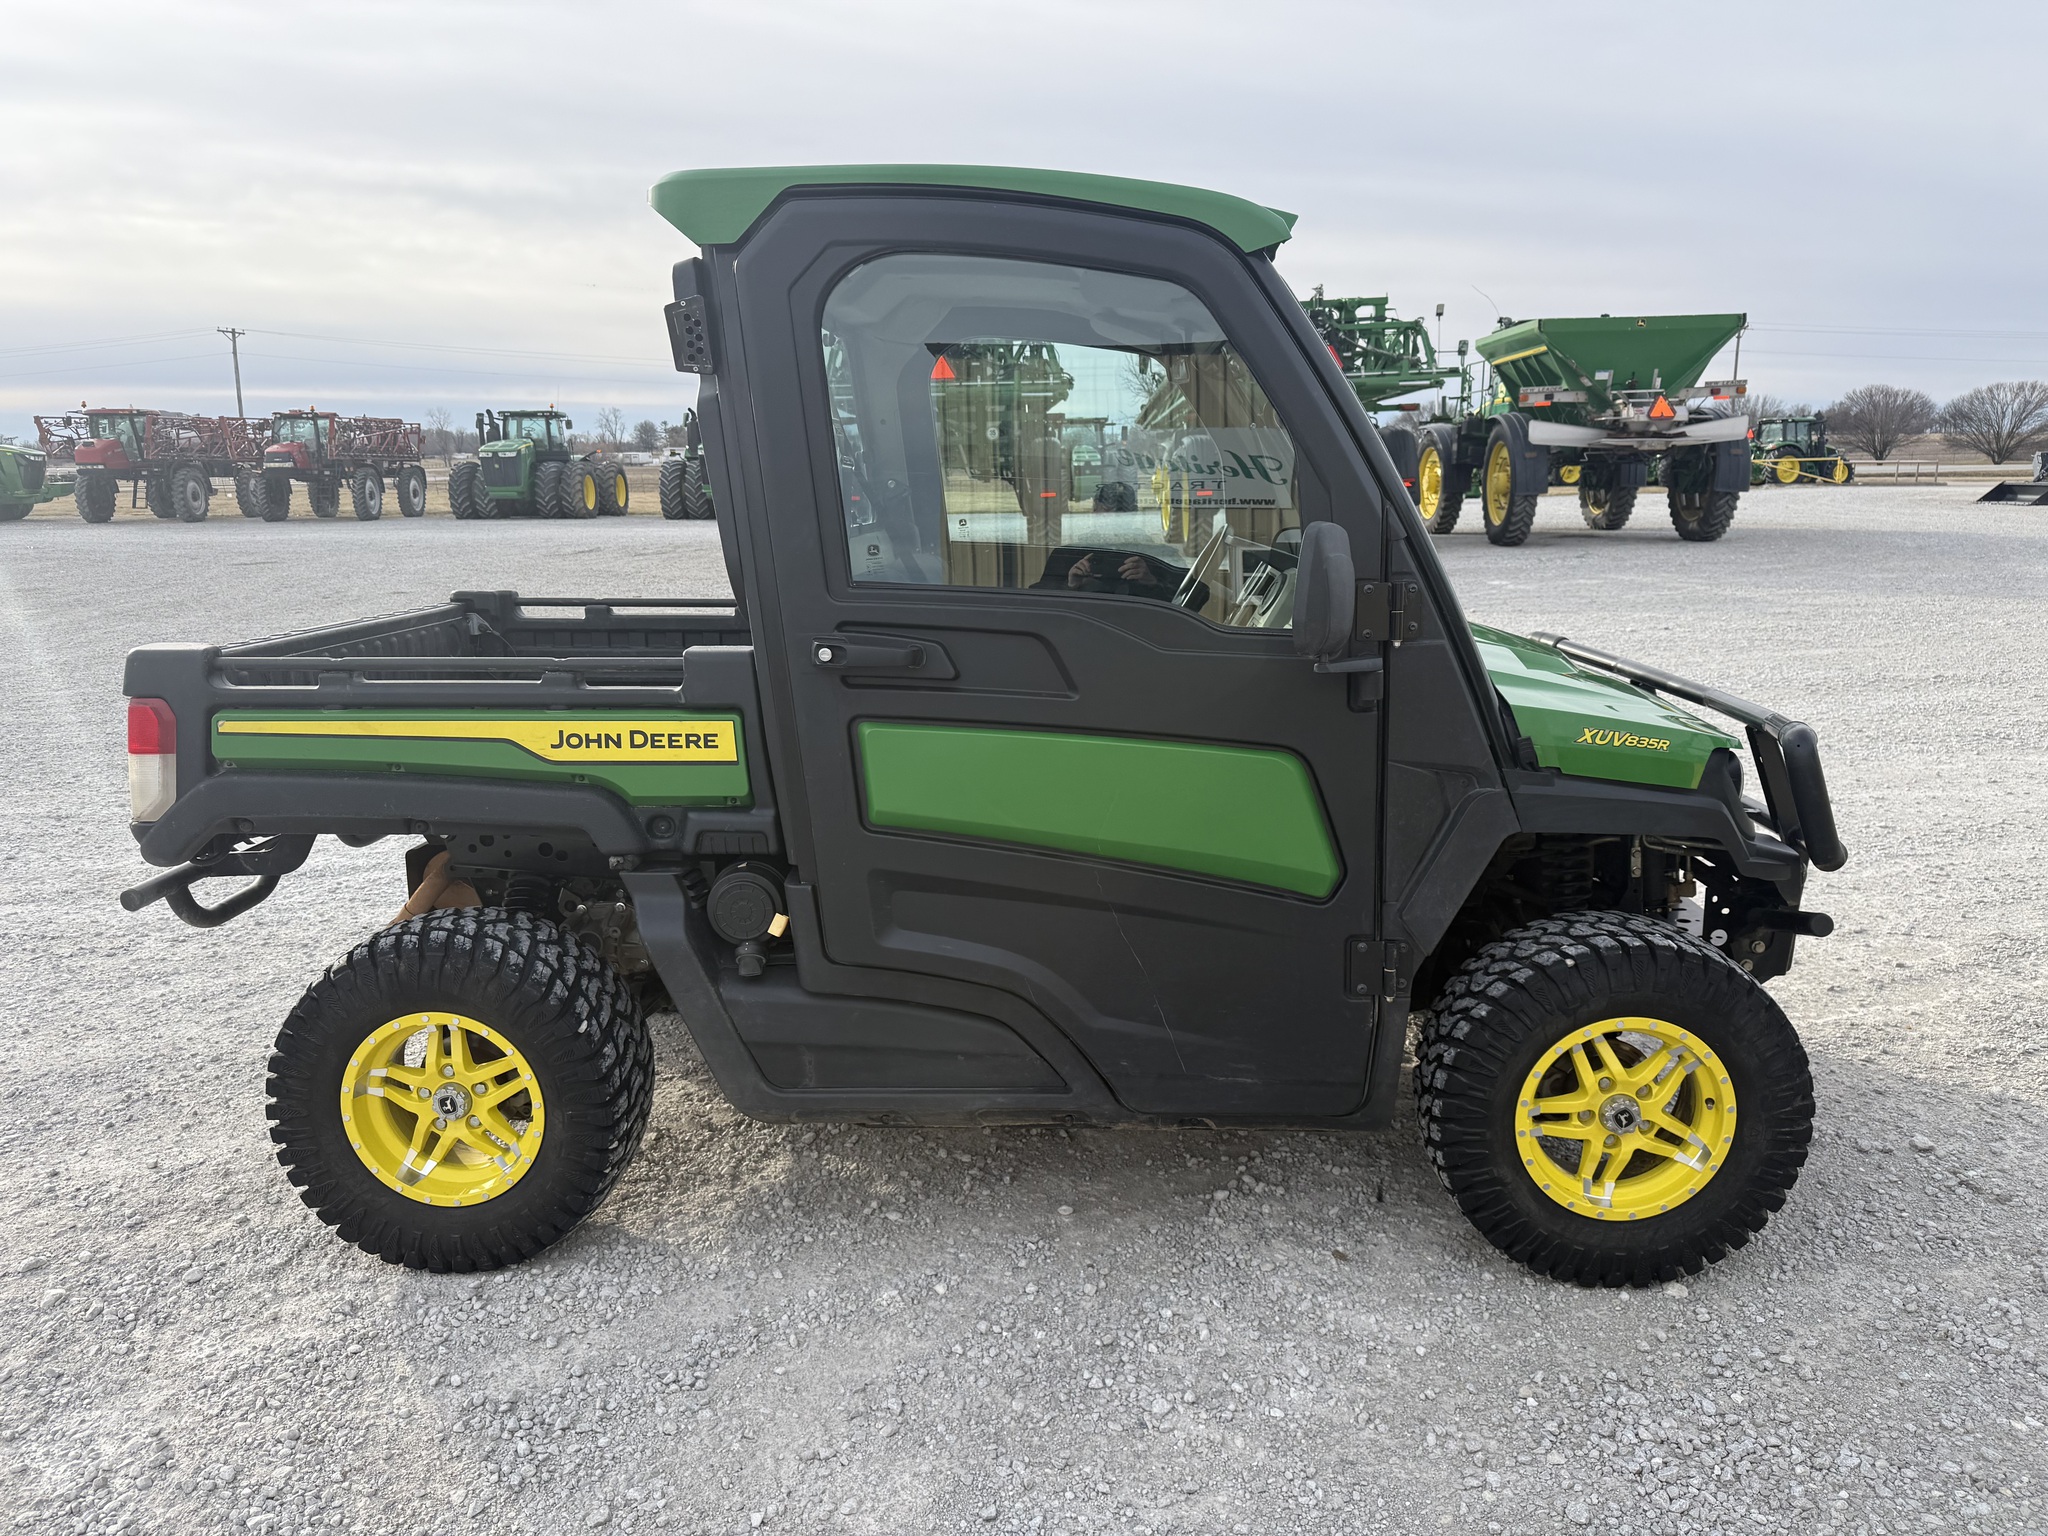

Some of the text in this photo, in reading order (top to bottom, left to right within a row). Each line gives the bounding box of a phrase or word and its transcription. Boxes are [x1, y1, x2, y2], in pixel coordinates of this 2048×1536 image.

[551, 730, 719, 749] JOHN DEERE
[1574, 727, 1671, 751] XUV835R
